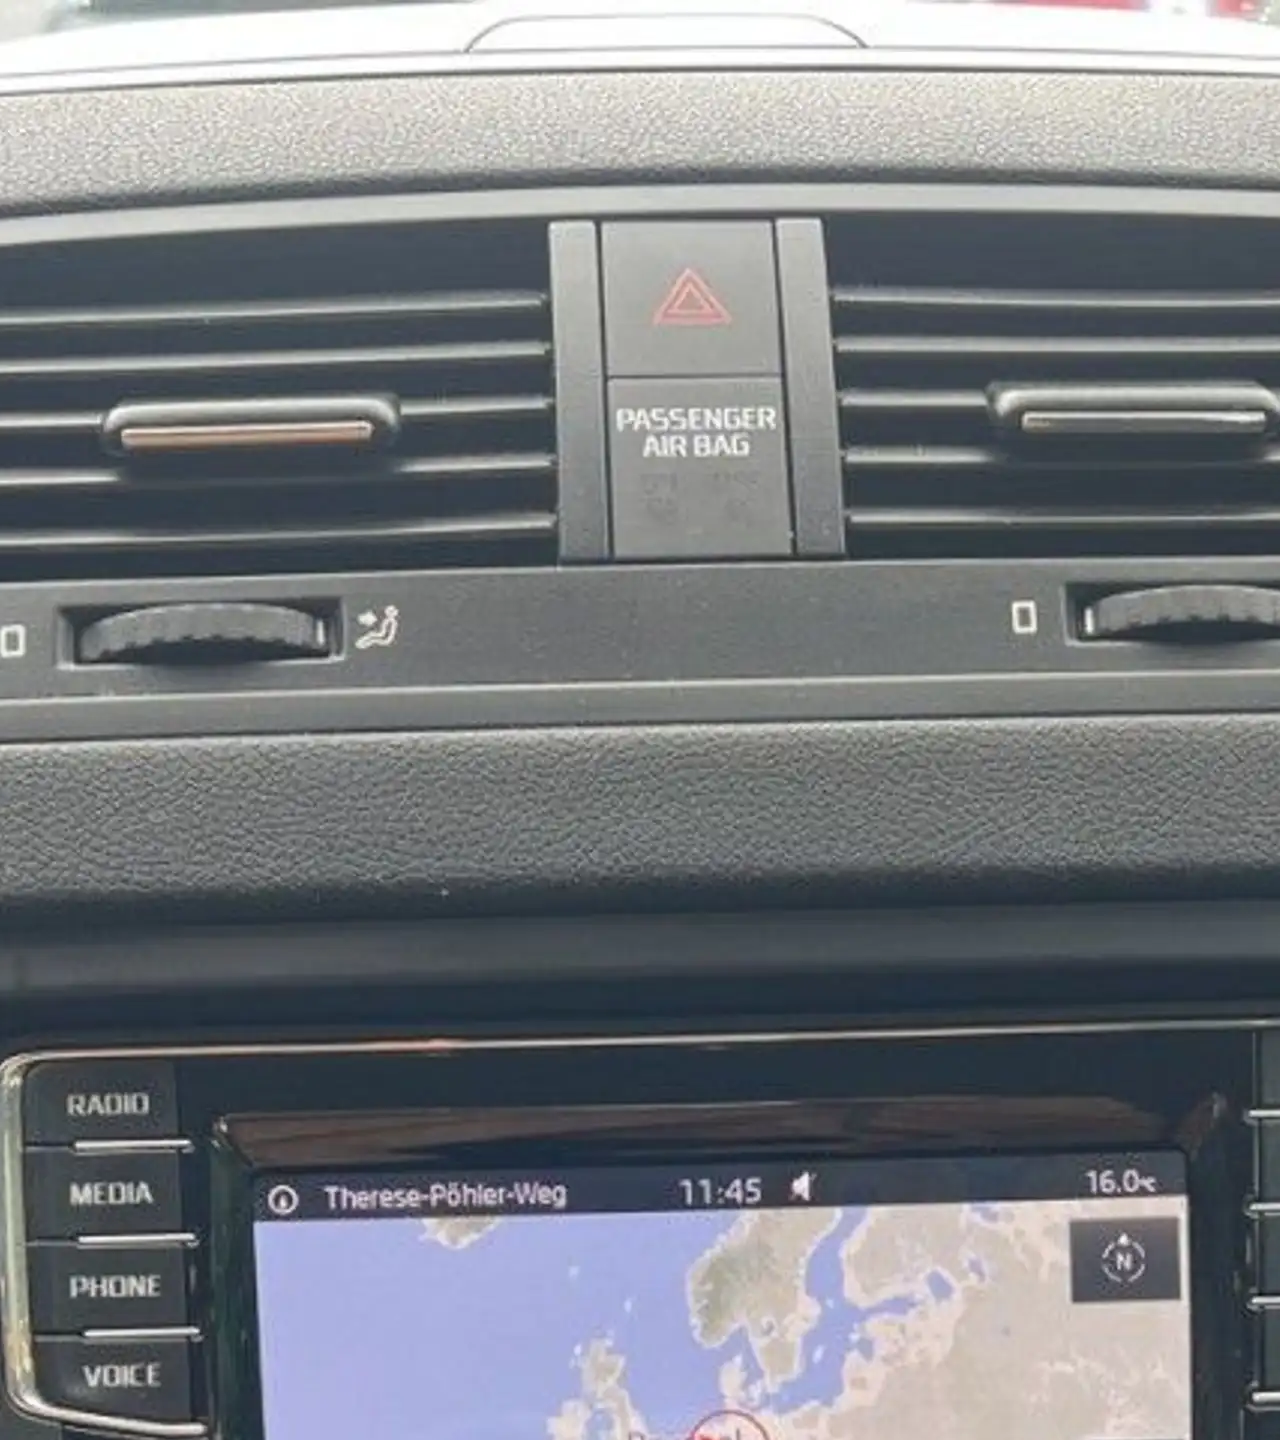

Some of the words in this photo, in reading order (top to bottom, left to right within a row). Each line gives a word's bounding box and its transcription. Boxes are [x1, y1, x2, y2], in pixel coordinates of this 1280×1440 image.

[615, 406, 777, 432] PASSENGER
[643, 435, 687, 458] AIR
[693, 433, 751, 457] BAG
[66, 1092, 150, 1117] RADIO
[69, 1181, 153, 1206] MEDIA
[324, 1181, 567, 1211] Therese-Pöhler-Weg
[678, 1176, 762, 1206] 11:45
[69, 1275, 161, 1298] PHONE
[83, 1363, 161, 1388] VOICE
